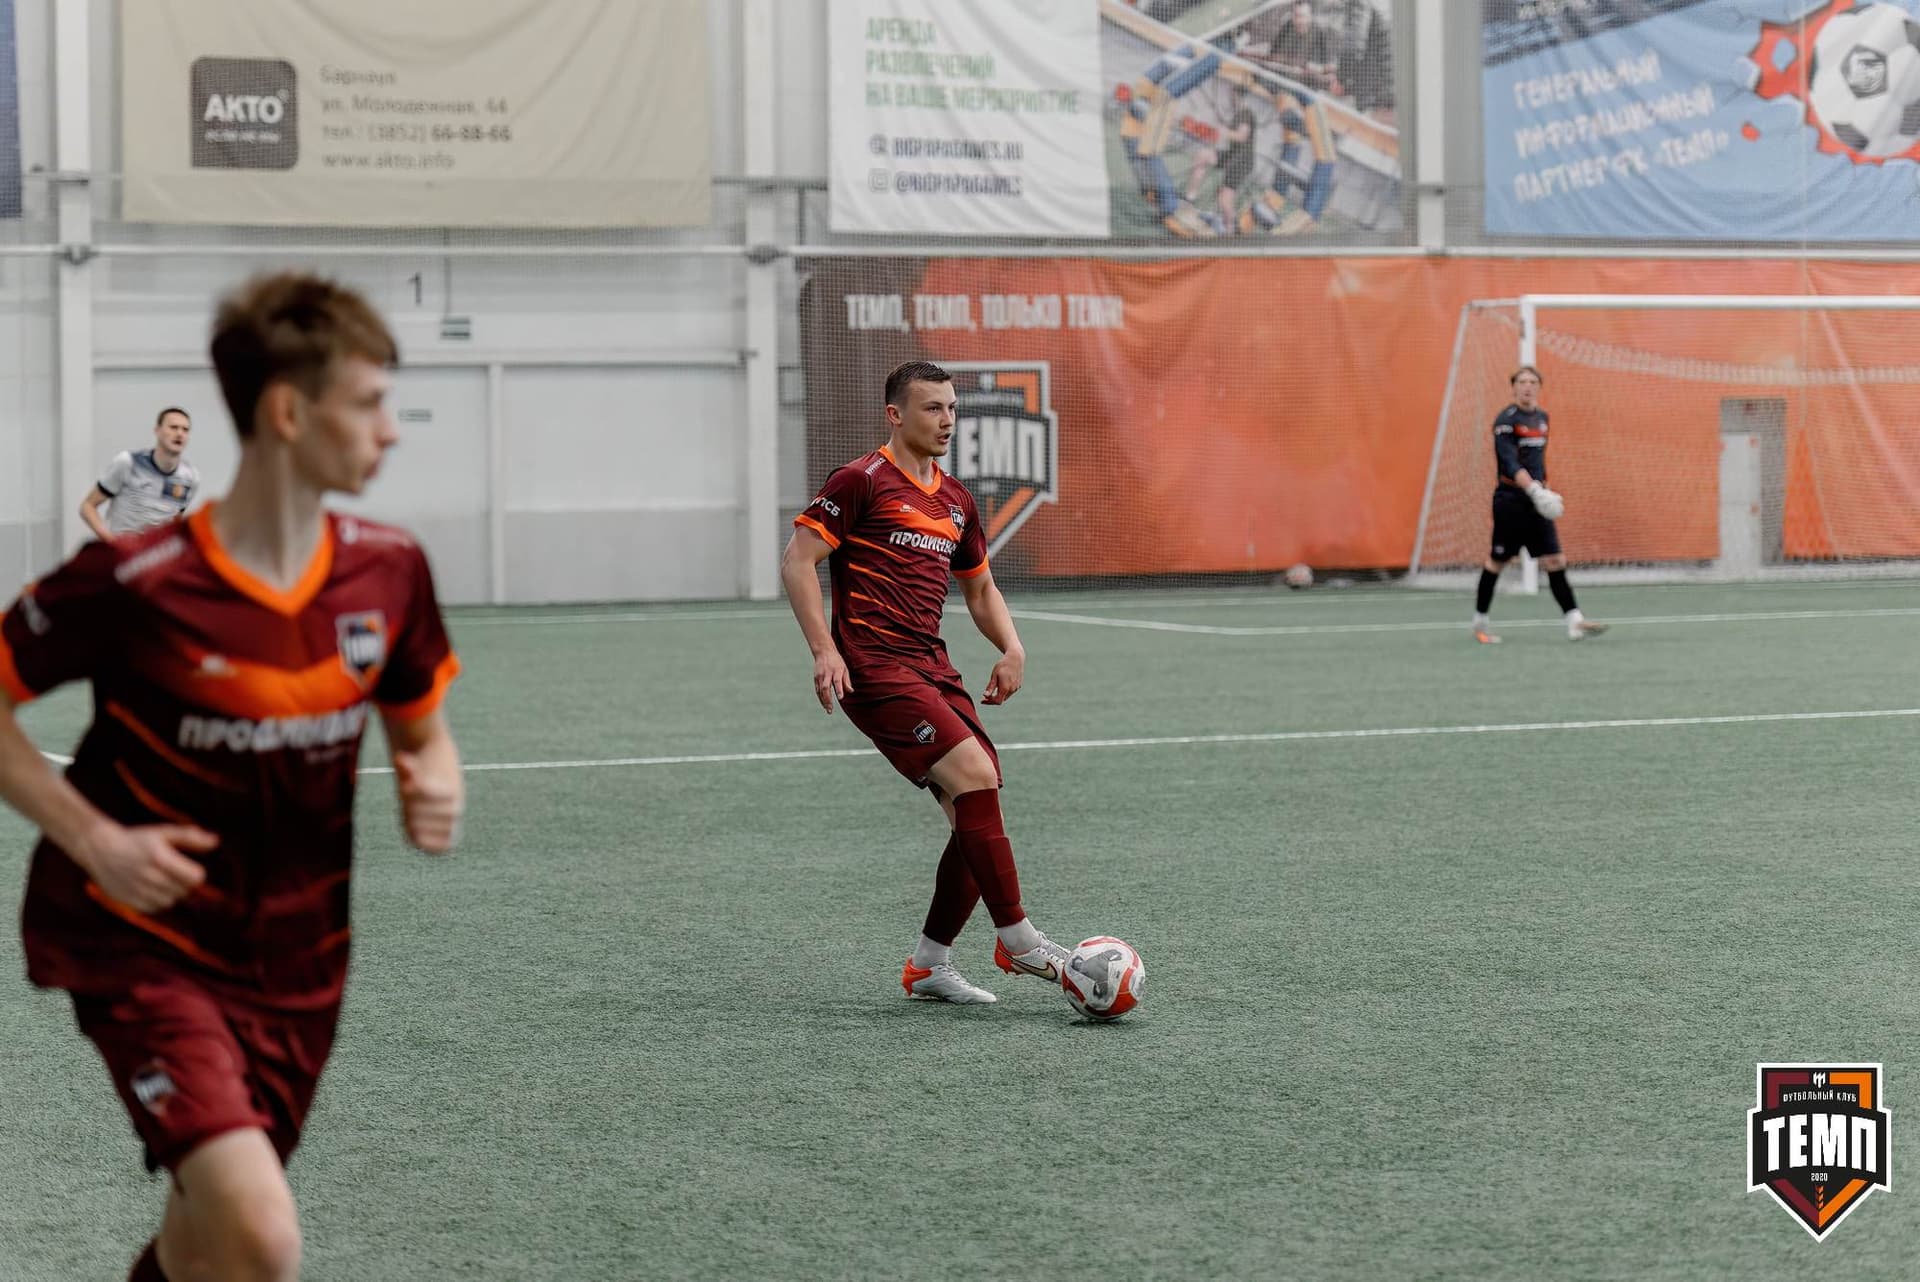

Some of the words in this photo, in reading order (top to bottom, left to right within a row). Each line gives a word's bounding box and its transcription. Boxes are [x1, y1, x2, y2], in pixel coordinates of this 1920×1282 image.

[865, 17, 937, 47] АРЕНДА
[1514, 47, 1662, 110] ГЕНЕРАЛЬНЫЙ
[408, 273, 422, 305] 1
[846, 294, 909, 332] ТЕМП,
[914, 294, 976, 332] ТЕМП,
[981, 294, 1061, 329] ТОЛЬКО
[957, 415, 1047, 484] ЕМП
